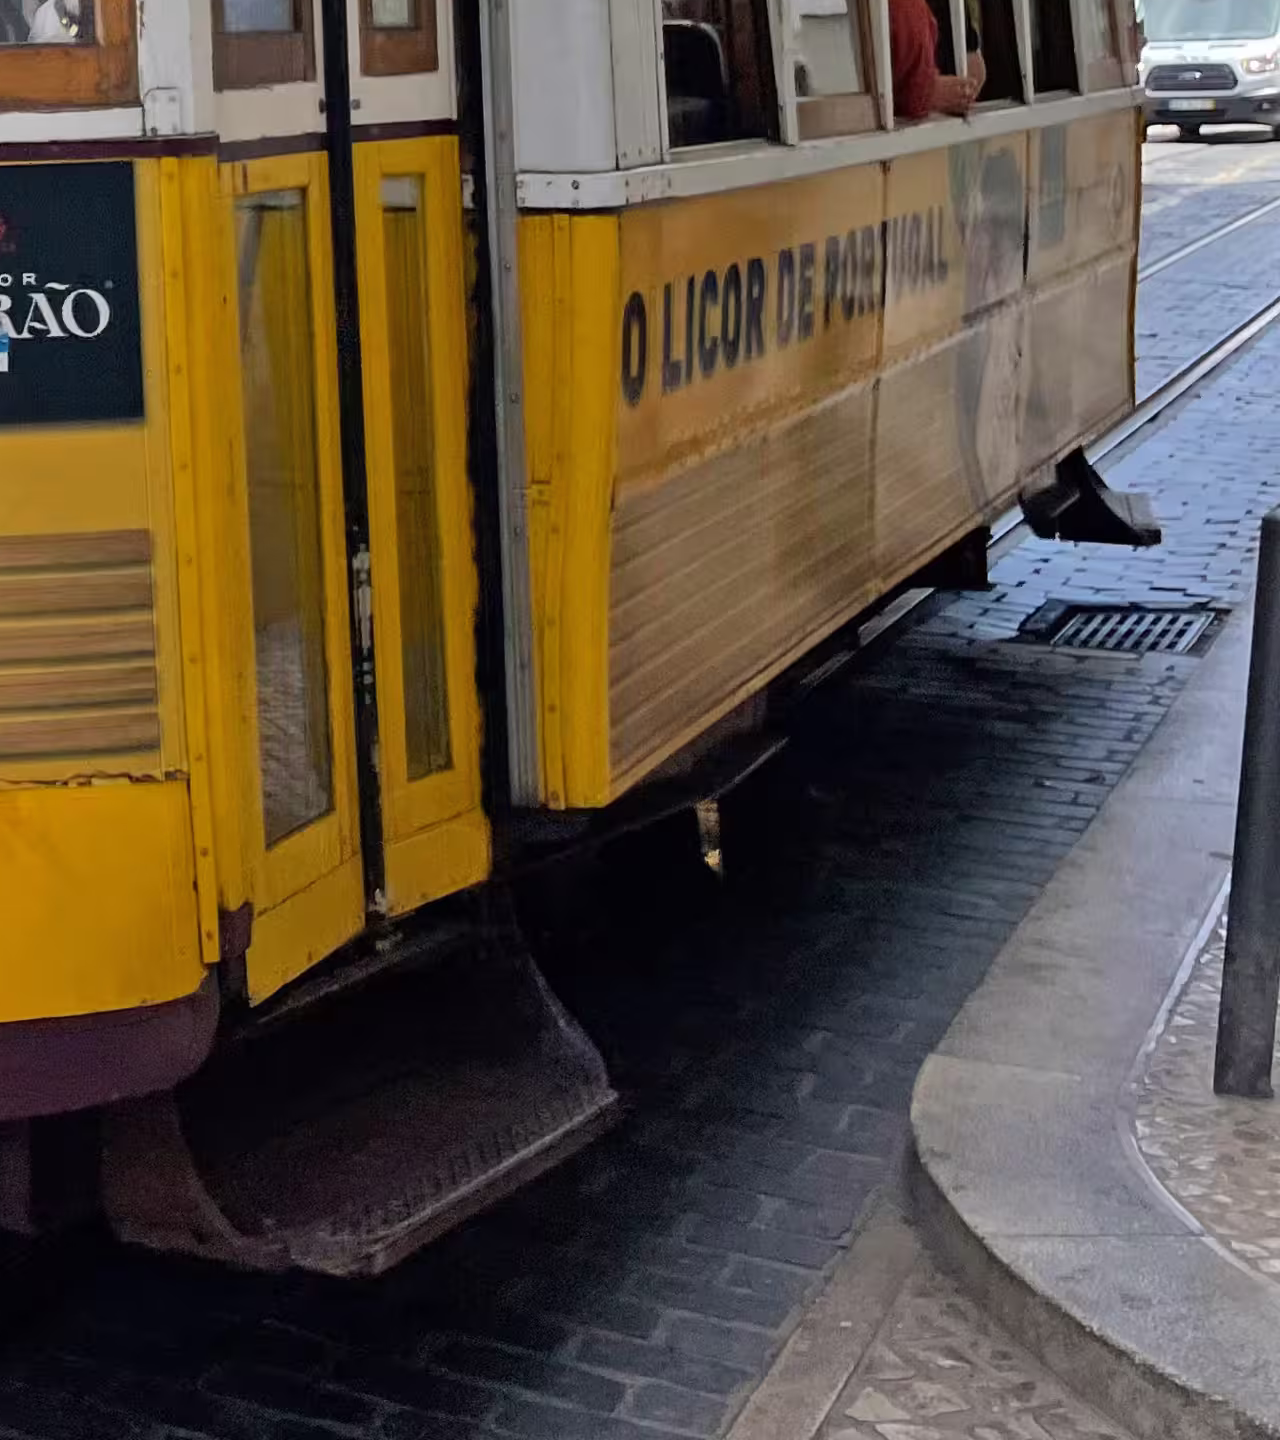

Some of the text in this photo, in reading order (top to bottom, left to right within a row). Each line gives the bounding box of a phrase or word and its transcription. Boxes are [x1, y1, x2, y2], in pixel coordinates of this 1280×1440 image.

[622, 290, 648, 408] O
[661, 256, 766, 398] LICOR
[776, 242, 816, 353] DE
